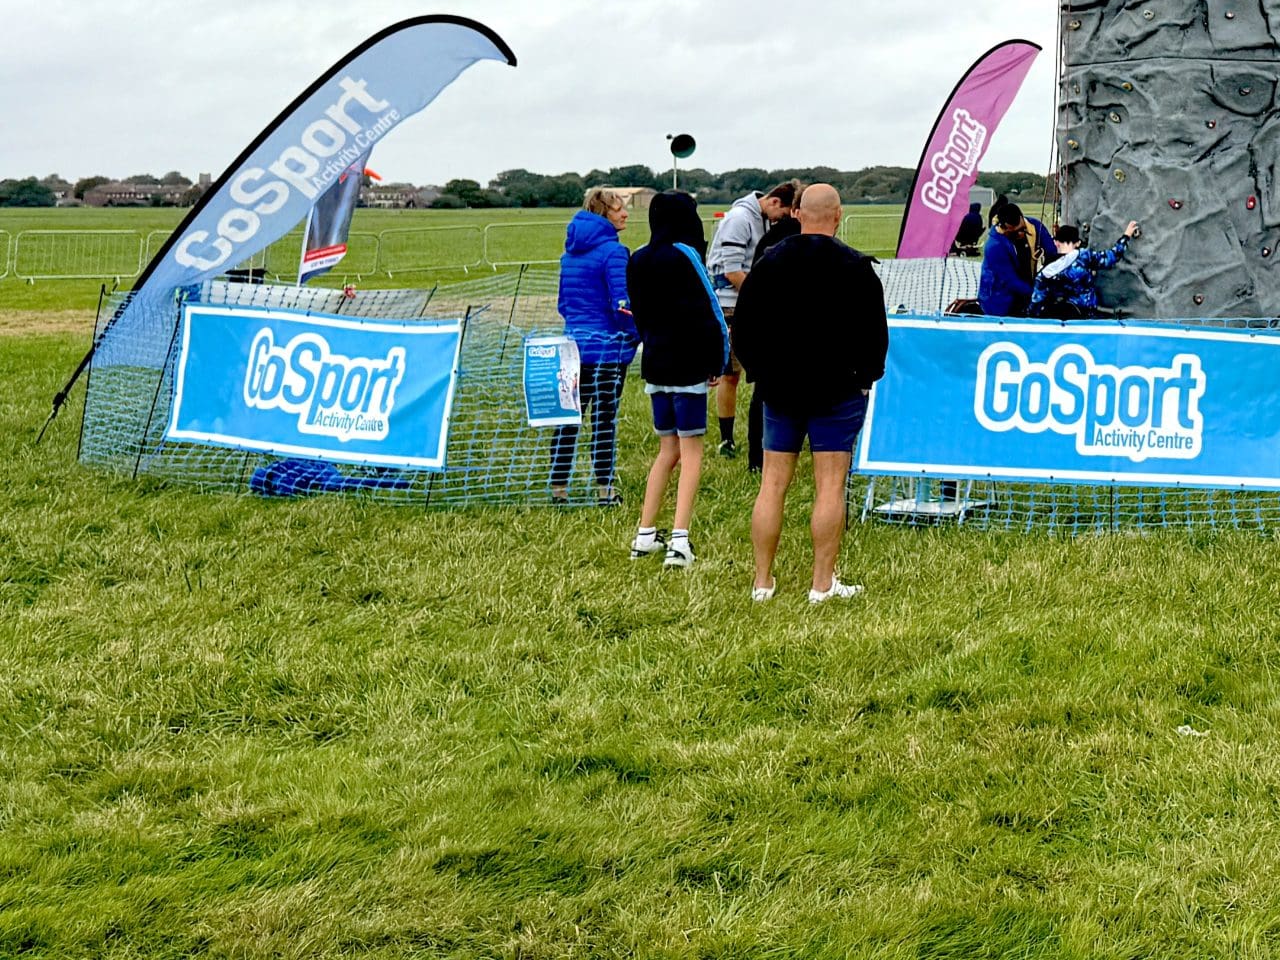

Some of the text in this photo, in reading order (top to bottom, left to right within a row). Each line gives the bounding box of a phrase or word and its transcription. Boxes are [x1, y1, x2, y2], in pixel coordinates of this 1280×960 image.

[312, 108, 400, 190] Activity Centre
[924, 112, 977, 209] GoSport
[247, 335, 400, 426] GoSport
[314, 410, 355, 434] Activity
[982, 350, 1198, 447] GoSport
[1094, 428, 1194, 452] Activity Centre
